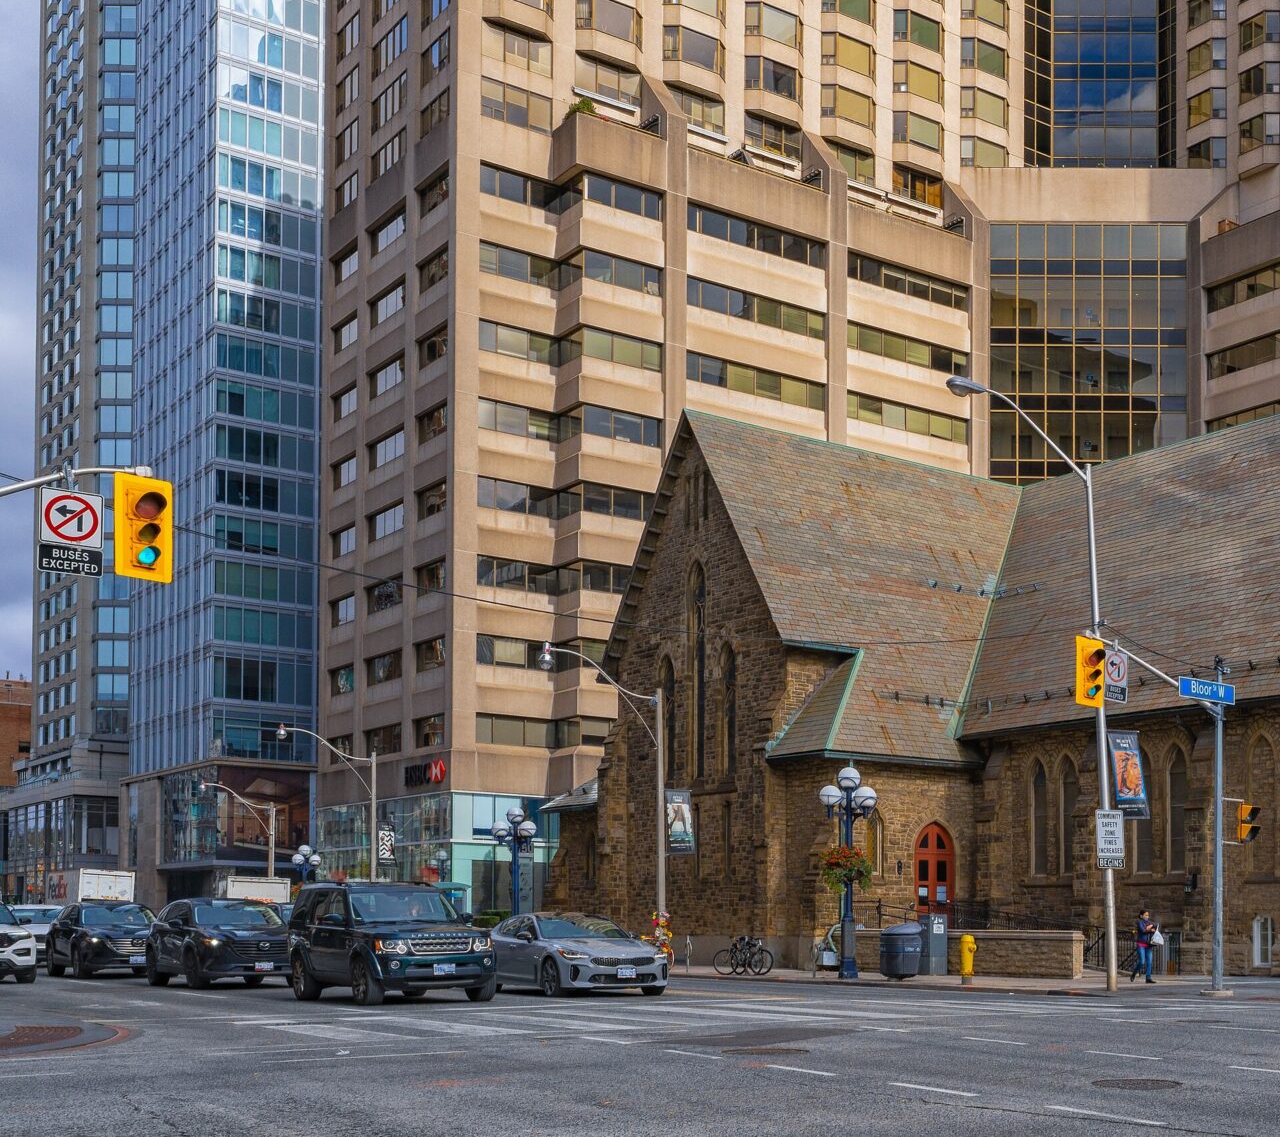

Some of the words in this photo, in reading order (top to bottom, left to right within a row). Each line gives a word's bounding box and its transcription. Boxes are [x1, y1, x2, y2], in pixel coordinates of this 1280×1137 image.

[52, 548, 89, 562] BUSES
[42, 558, 98, 573] EXCEPTED
[1191, 680, 1211, 696] Bloor
[1218, 686, 1225, 698] W
[404, 763, 431, 788] HSBC
[1104, 829, 1116, 837] ZONE
[1099, 847, 1123, 855] INCREASED
[1099, 858, 1123, 867] BEGINS
[48, 873, 68, 899] FedEx
